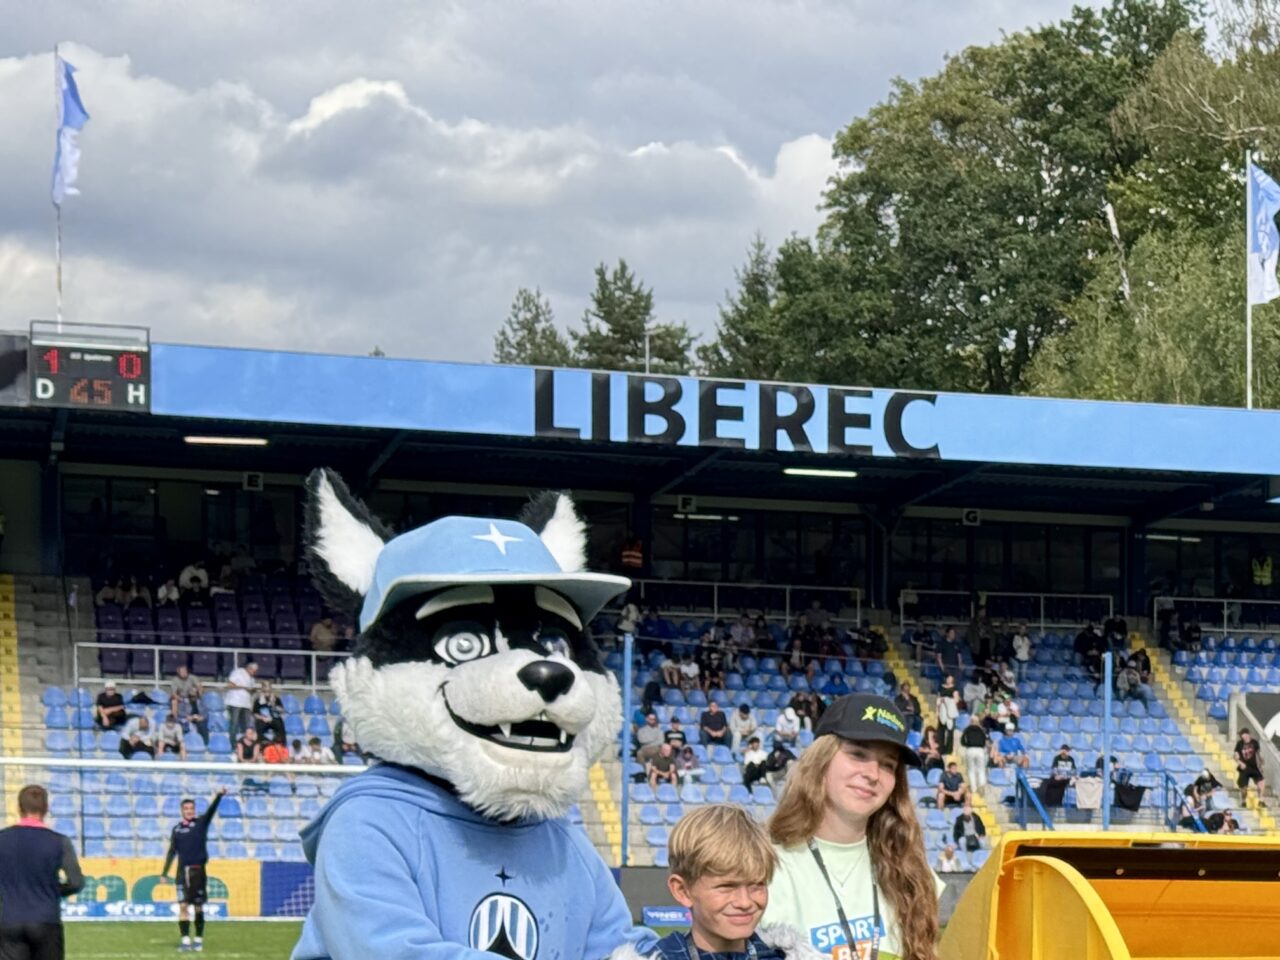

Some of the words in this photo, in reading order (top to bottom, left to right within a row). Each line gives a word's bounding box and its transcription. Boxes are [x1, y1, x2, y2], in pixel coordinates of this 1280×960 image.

[43, 348, 60, 374] 1
[118, 352, 142, 379] 0
[36, 377, 55, 399] D
[69, 378, 113, 404] 45
[127, 383, 146, 404] H
[534, 368, 942, 459] LIBEREC
